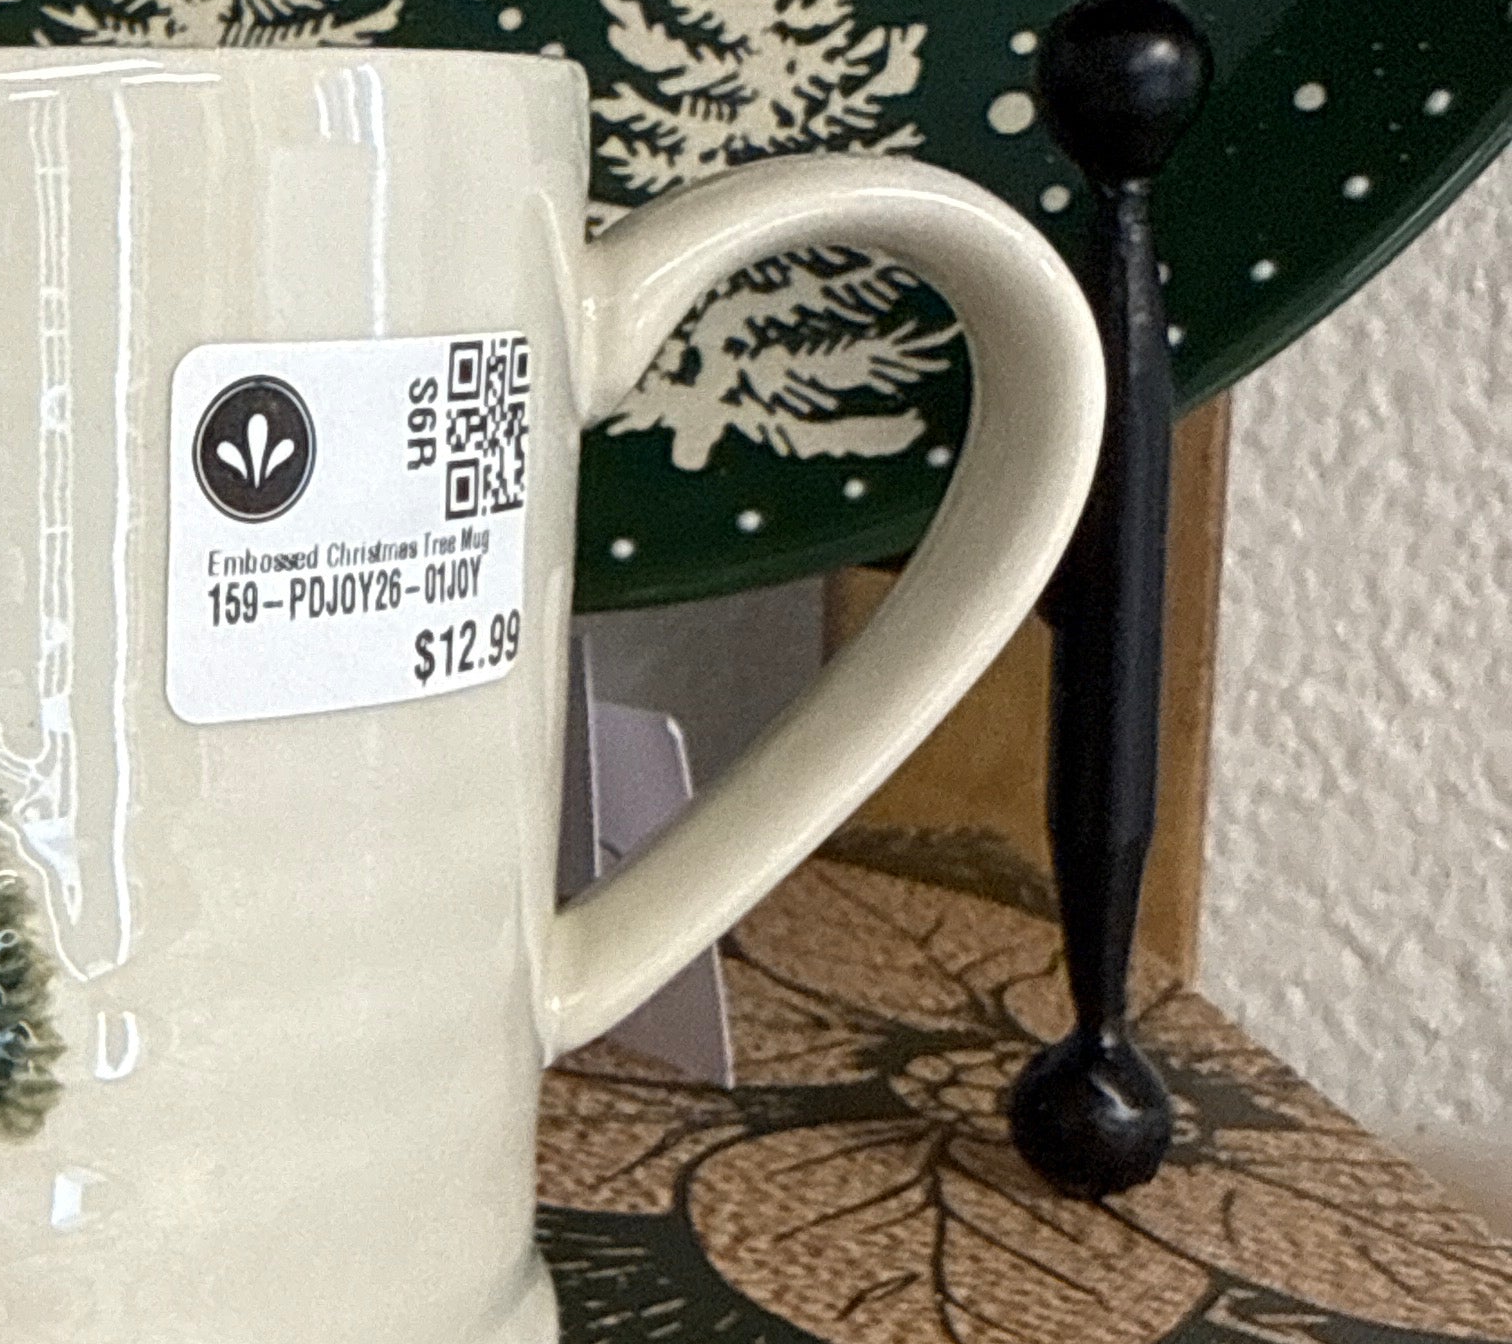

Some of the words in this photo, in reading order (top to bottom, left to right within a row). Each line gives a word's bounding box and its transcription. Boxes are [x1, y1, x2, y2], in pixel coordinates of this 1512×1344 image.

[407, 376, 439, 471] S6R
[207, 544, 319, 578] Embossed
[326, 537, 419, 569] Christmas
[423, 530, 457, 558] Tree
[460, 524, 490, 554] Mug
[413, 608, 521, 687] $12.99
